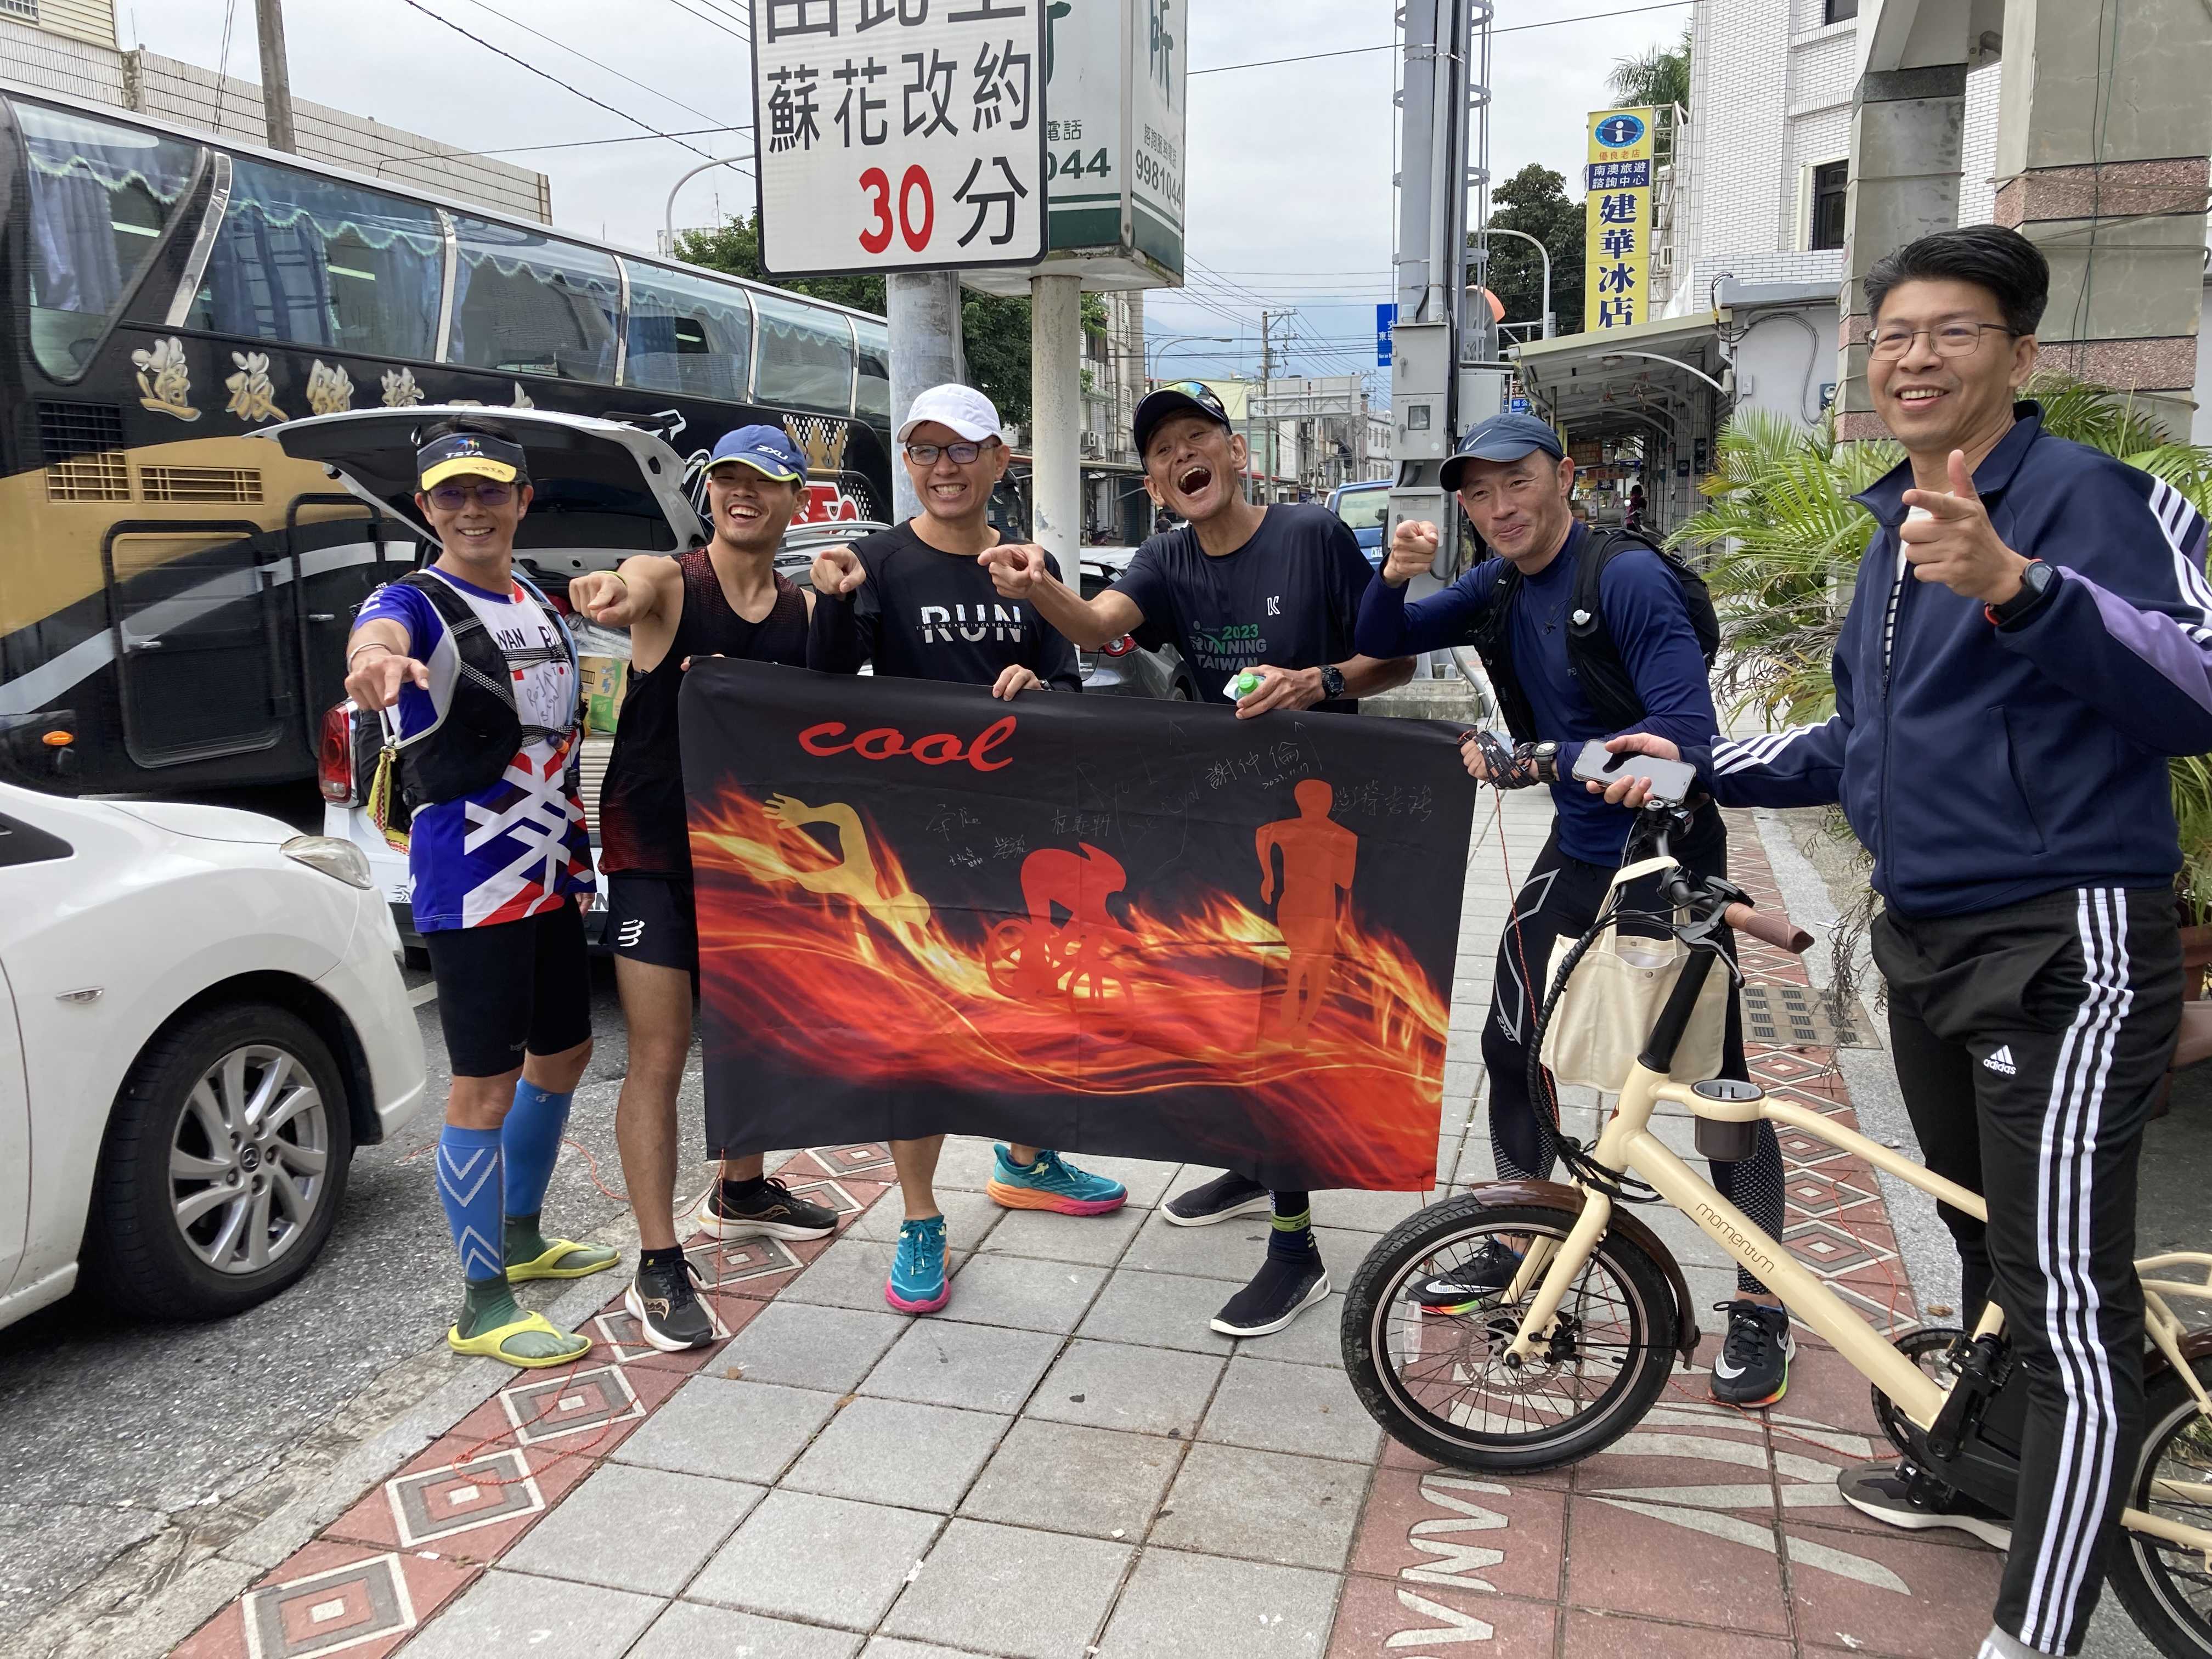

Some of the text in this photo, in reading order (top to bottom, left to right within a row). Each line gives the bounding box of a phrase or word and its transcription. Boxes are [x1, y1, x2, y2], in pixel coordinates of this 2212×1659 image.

[767, 39, 1031, 153] 蘇花改約
[1599, 149, 1640, 161] 優良老店
[1593, 161, 1646, 177] 南澳旅遊
[1136, 149, 1182, 211] 9981044
[1592, 175, 1645, 189] 諮詢中心
[1598, 193, 1638, 328] 建華冰店
[445, 450, 484, 459] TSTA
[474, 466, 505, 475] TSTA
[920, 604, 1022, 644] RUN
[1221, 623, 1260, 640] 2023
[1189, 638, 1267, 654] RUNNING
[1195, 653, 1259, 672] TAIWAN
[798, 715, 1017, 771] cool
[1983, 1058, 2017, 1075] adidas
[1696, 1203, 1774, 1274] momentum
